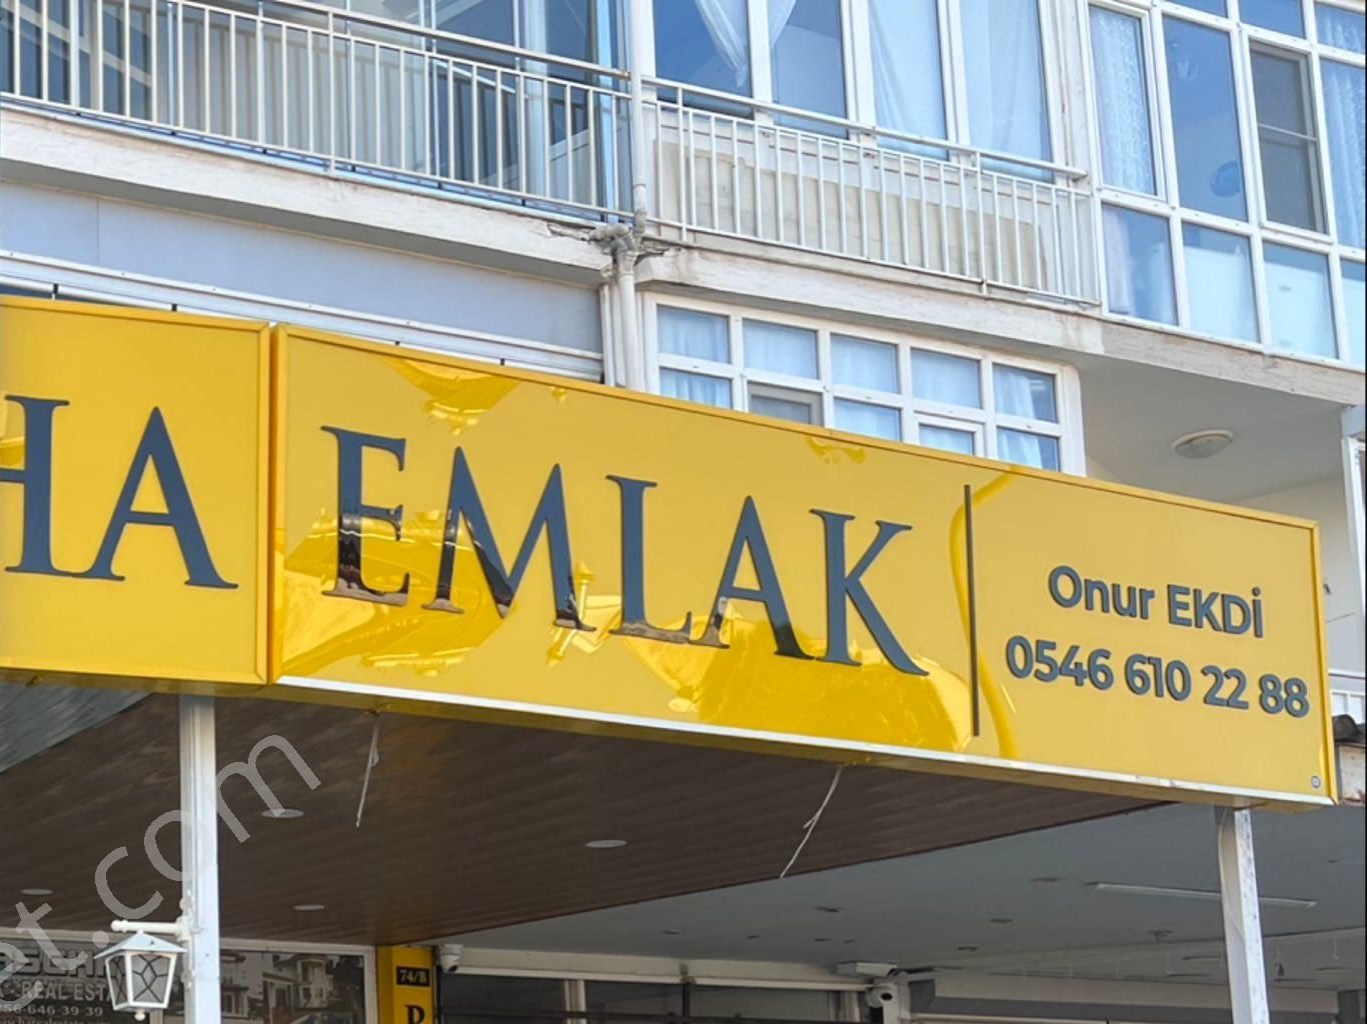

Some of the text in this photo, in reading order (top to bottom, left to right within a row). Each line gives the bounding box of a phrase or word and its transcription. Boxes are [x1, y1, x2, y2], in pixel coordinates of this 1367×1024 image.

[320, 426, 930, 676] EMLAK
[1048, 565, 1264, 639] Onur EKDİ
[1005, 635, 1310, 718] 0546 610 22 88
